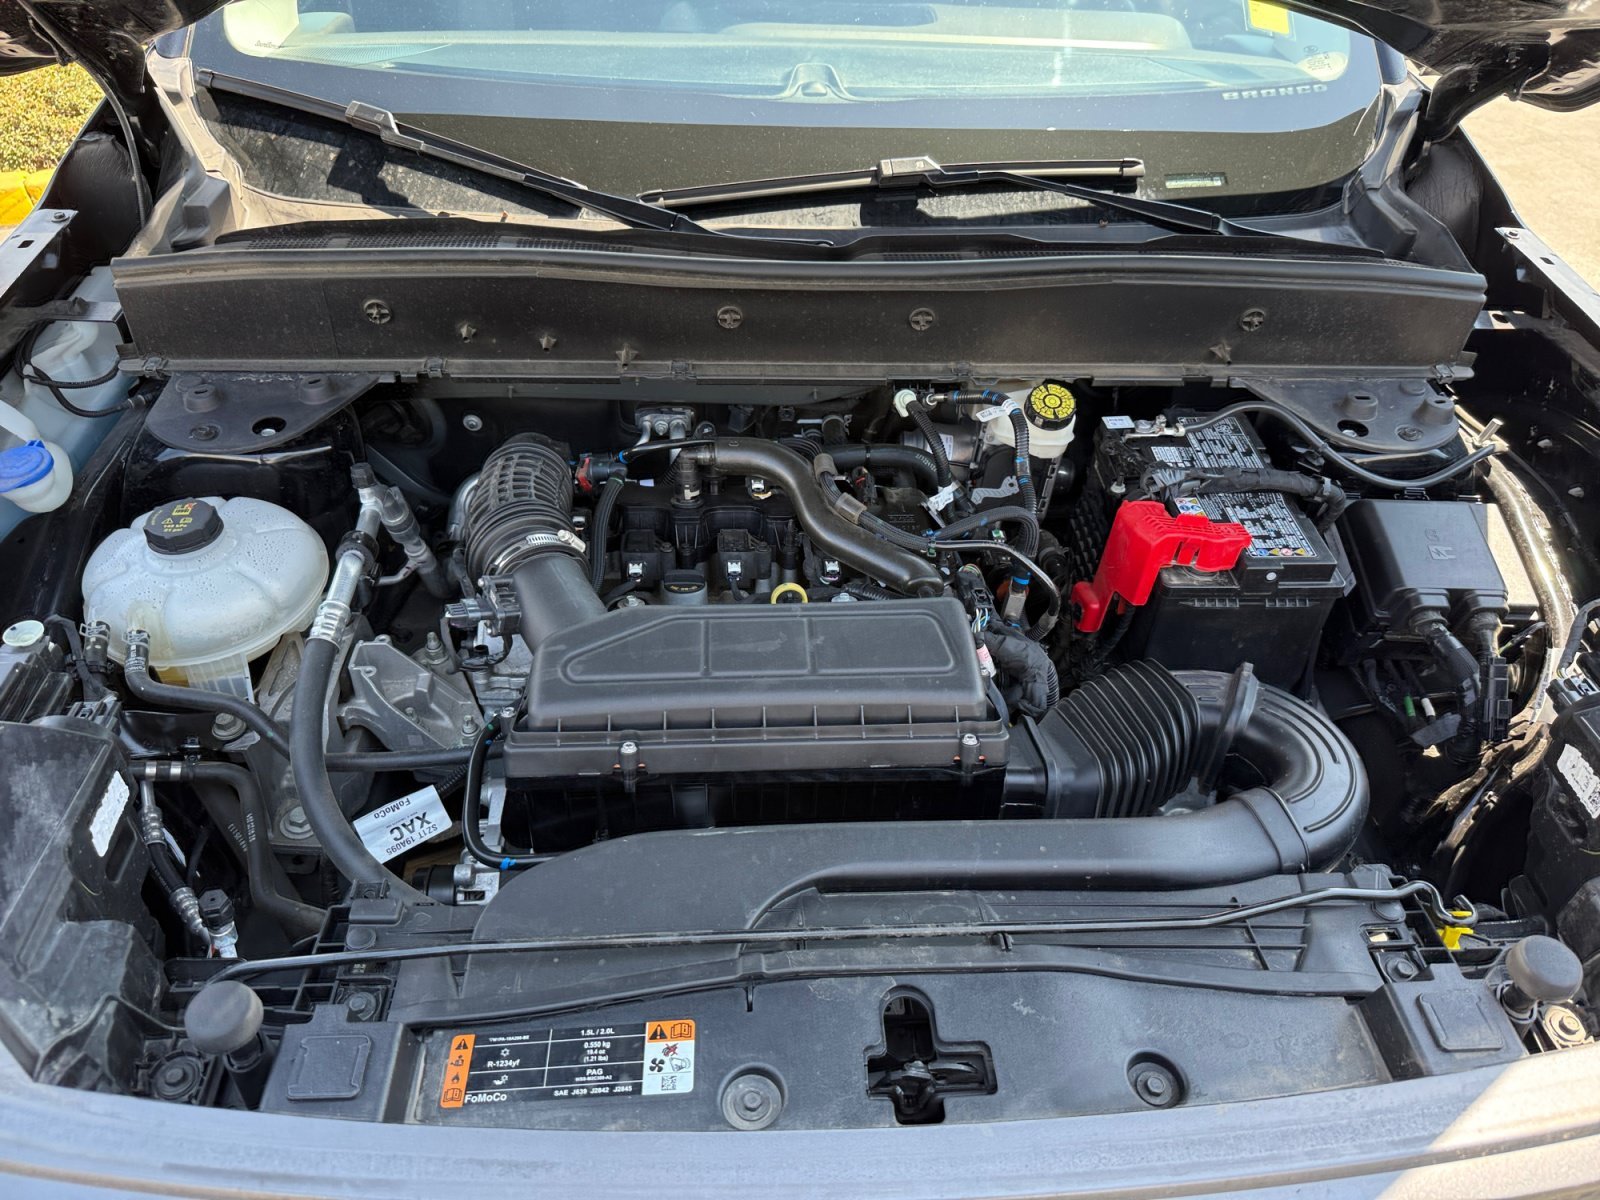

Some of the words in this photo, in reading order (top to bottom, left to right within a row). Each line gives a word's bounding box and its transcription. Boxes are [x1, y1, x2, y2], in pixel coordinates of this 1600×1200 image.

[1222, 84, 1328, 101] BRONCO
[374, 798, 411, 819] FoMoCo
[390, 812, 433, 842] XAC
[386, 836, 416, 856] 19A095
[584, 1041, 601, 1049] 0.550
[602, 1041, 611, 1049] kg
[487, 1059, 520, 1068] R-1234yf
[586, 1068, 603, 1076] PAG
[553, 1089, 569, 1097] SAE
[590, 1086, 610, 1094] J2842
[612, 1085, 633, 1093] J2845
[464, 1092, 507, 1104] FoMoCo
